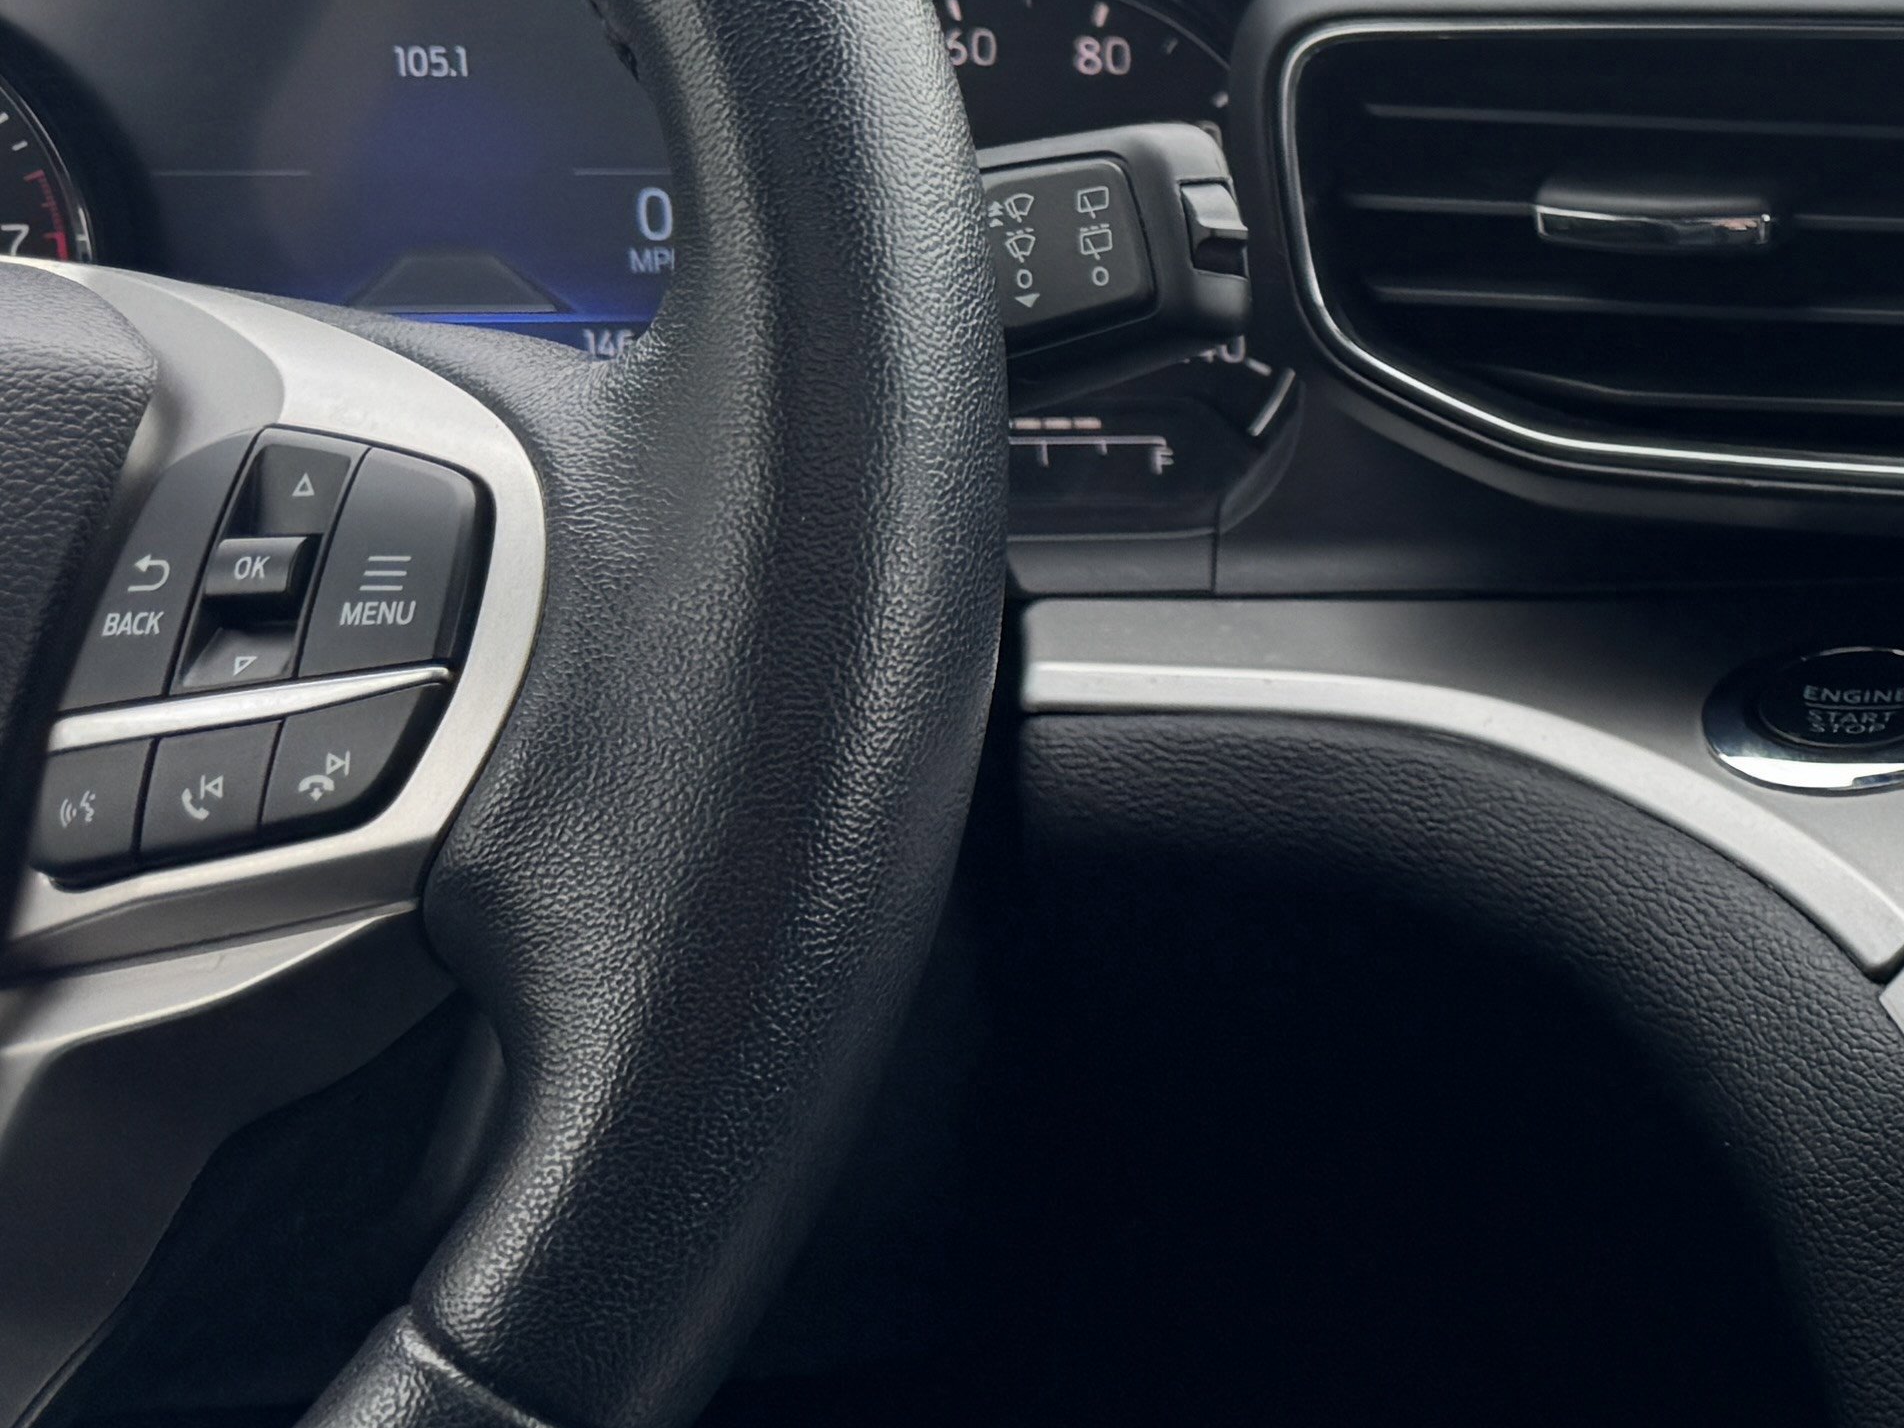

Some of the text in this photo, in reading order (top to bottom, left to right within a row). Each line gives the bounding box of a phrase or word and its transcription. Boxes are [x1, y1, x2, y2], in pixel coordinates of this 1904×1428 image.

[394, 45, 468, 77] 105.1
[1073, 35, 1132, 76] 80
[637, 187, 673, 241] 0
[1151, 446, 1174, 475] F
[234, 556, 270, 580] OK
[101, 611, 163, 637] BACK
[339, 600, 417, 626] MENU
[1807, 708, 1899, 724] START
[1809, 722, 1887, 735] STOP
